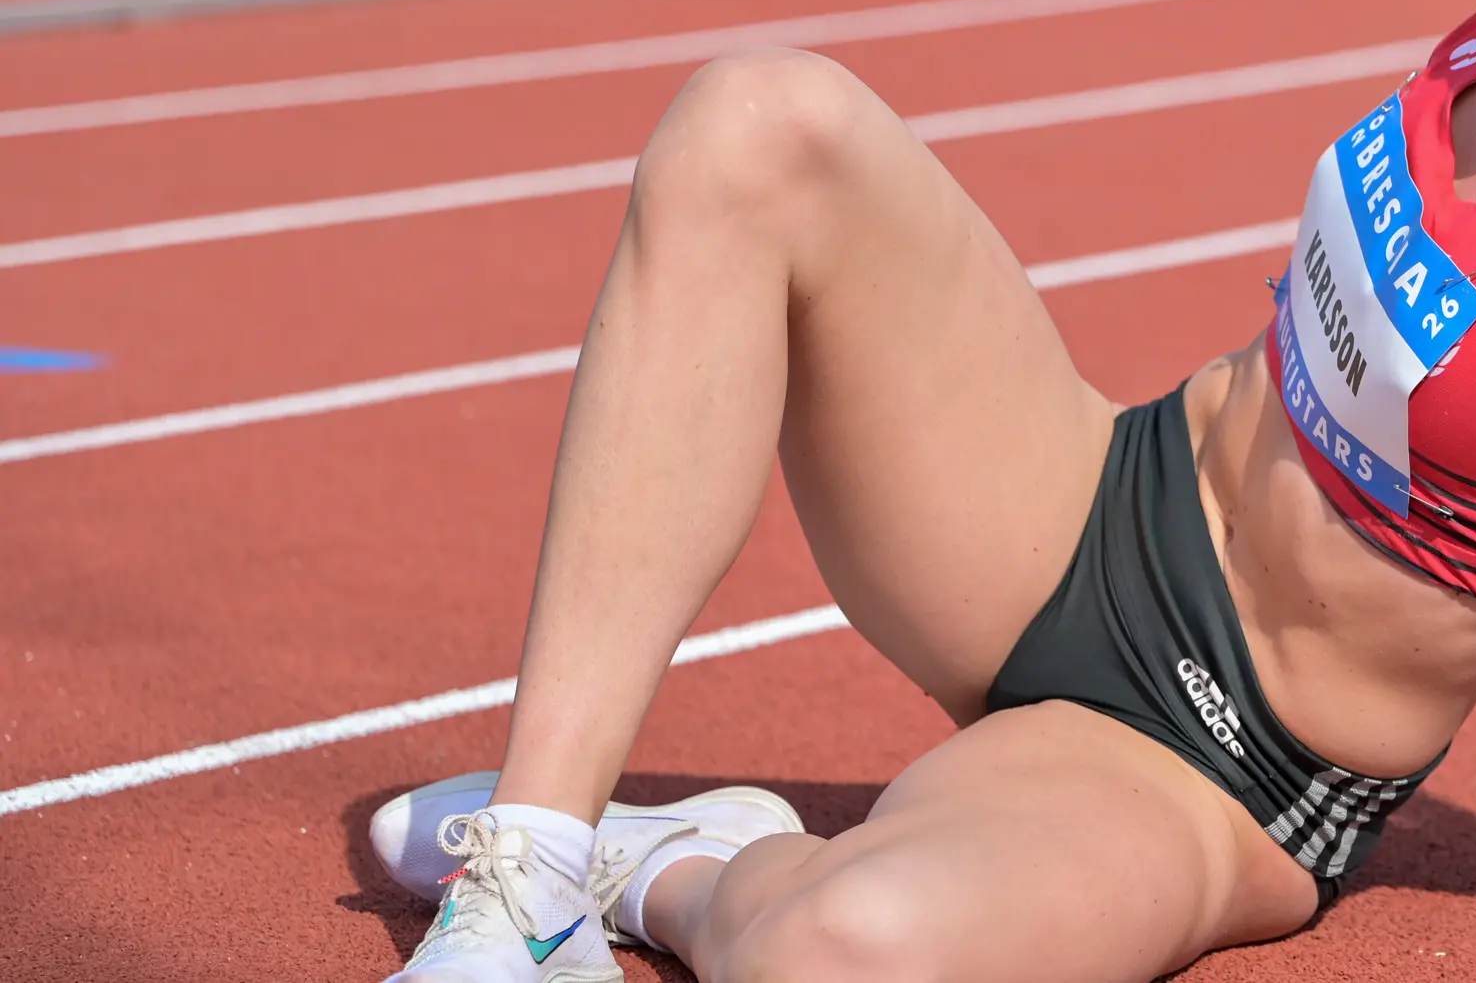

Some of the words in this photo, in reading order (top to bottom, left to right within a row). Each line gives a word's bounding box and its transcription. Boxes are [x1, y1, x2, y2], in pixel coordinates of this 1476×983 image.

[1304, 229, 1367, 397] KARLSSON
[1356, 133, 1428, 308] BRESCIA
[1422, 295, 1459, 339] 26
[1177, 658, 1244, 758] adidas
